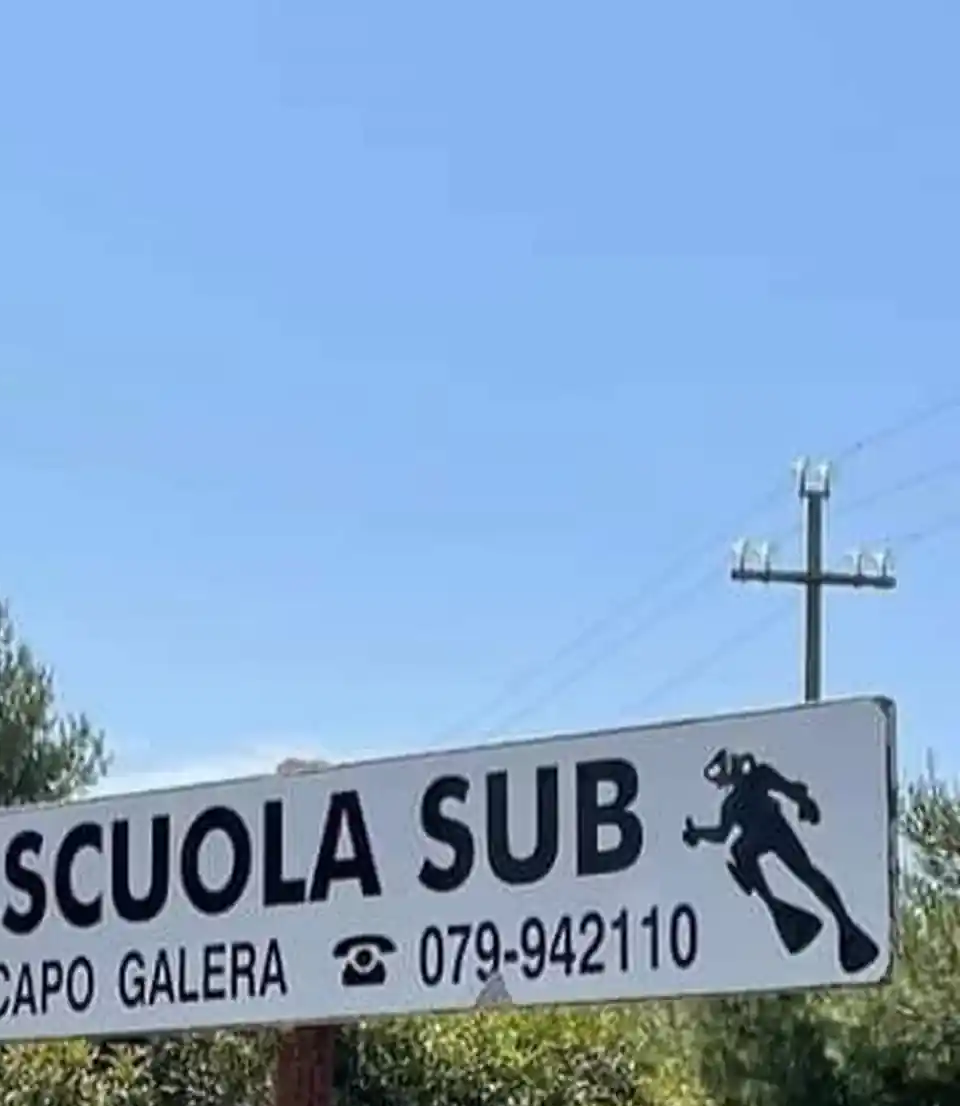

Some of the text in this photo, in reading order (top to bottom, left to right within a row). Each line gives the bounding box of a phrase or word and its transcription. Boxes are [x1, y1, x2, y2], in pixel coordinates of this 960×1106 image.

[2, 755, 646, 936] SCUOLA SUB
[117, 937, 288, 1003] GALERA
[418, 902, 698, 986] 079-942110
